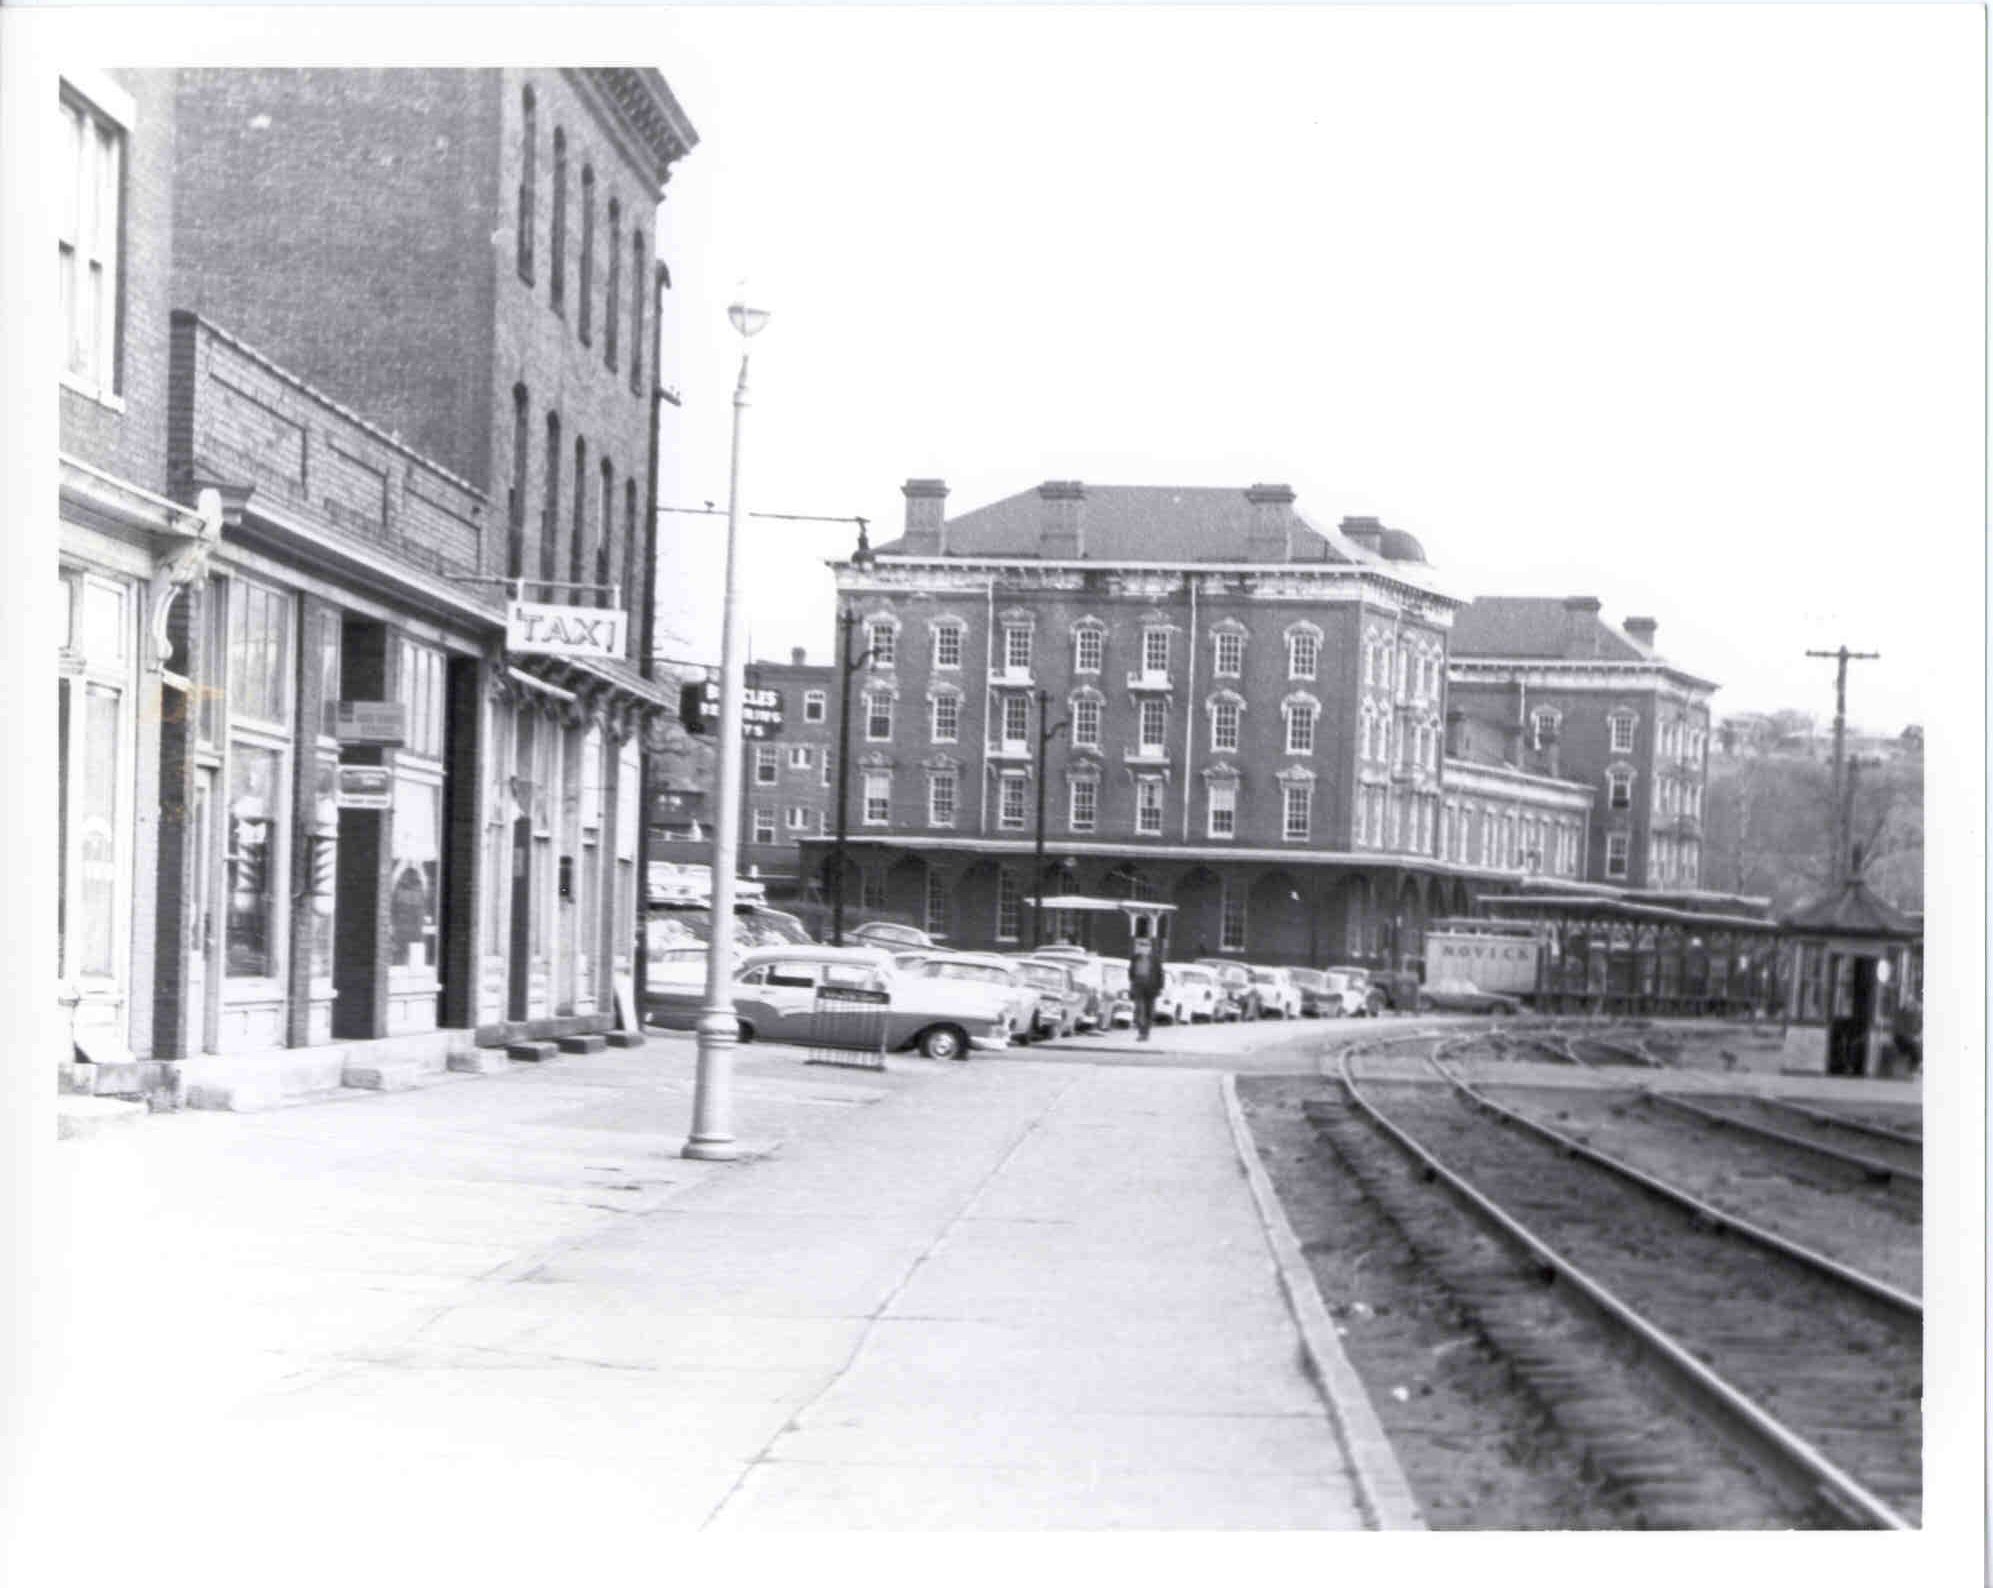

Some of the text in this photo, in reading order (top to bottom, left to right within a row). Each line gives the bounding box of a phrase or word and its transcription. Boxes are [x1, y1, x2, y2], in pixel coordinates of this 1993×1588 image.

[516, 607, 616, 653] TAXI
[706, 683, 778, 707] BCLES
[1442, 945, 1530, 960] NOVICK
